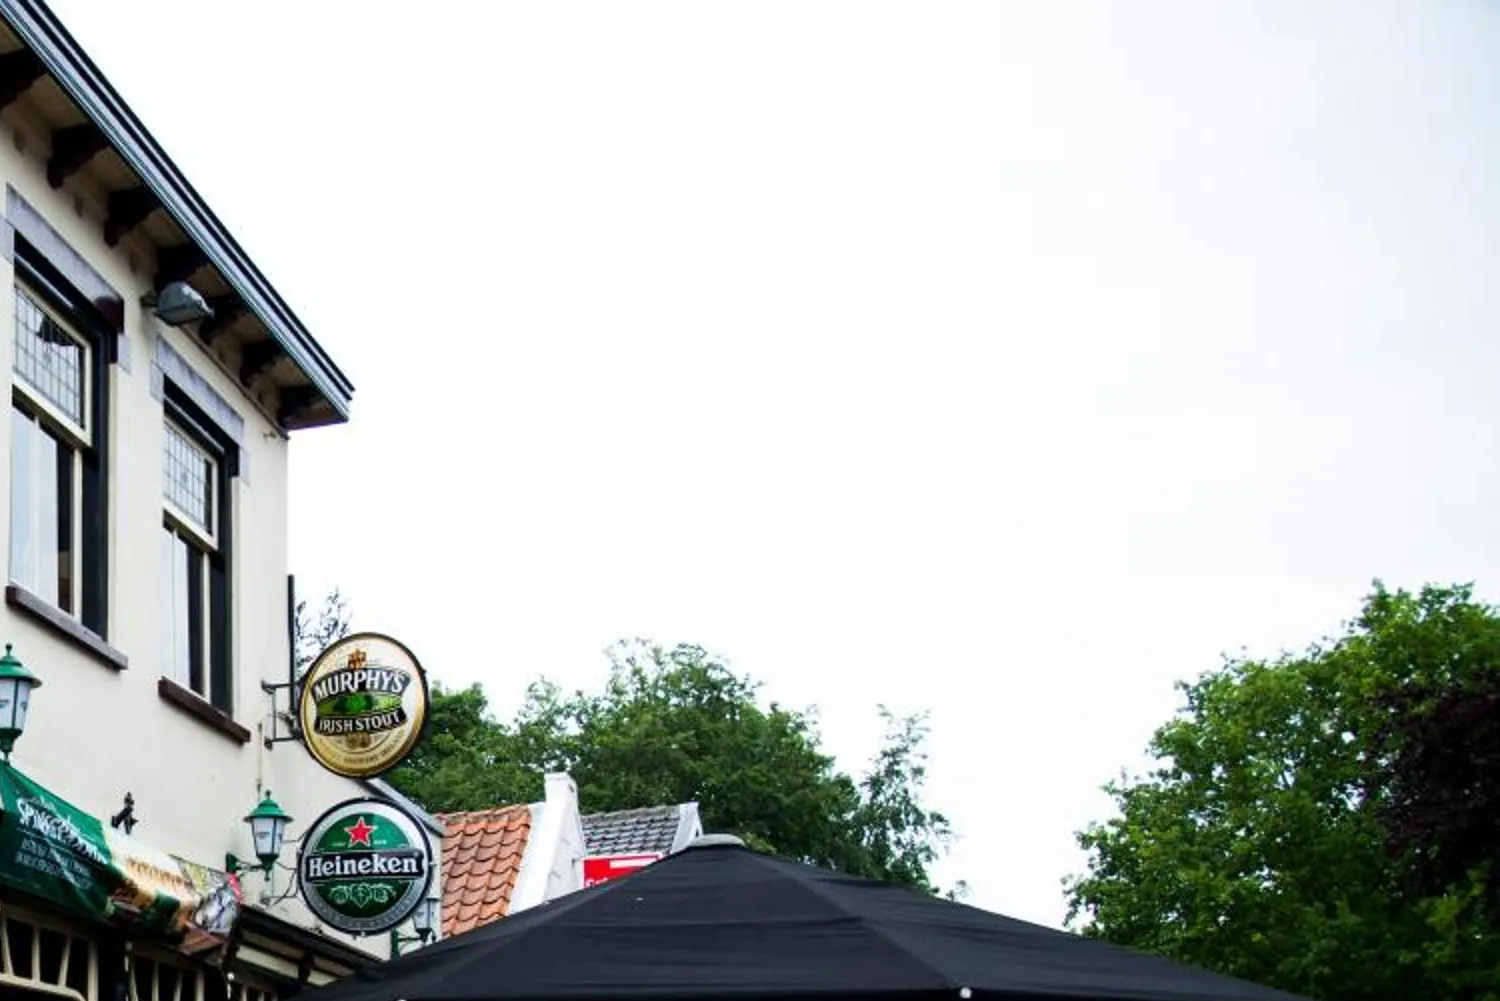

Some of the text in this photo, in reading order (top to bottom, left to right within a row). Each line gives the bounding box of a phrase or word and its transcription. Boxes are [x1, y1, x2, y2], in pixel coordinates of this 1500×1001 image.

[320, 711, 399, 733] IRISH STOUT
[308, 853, 419, 878] Heineken
